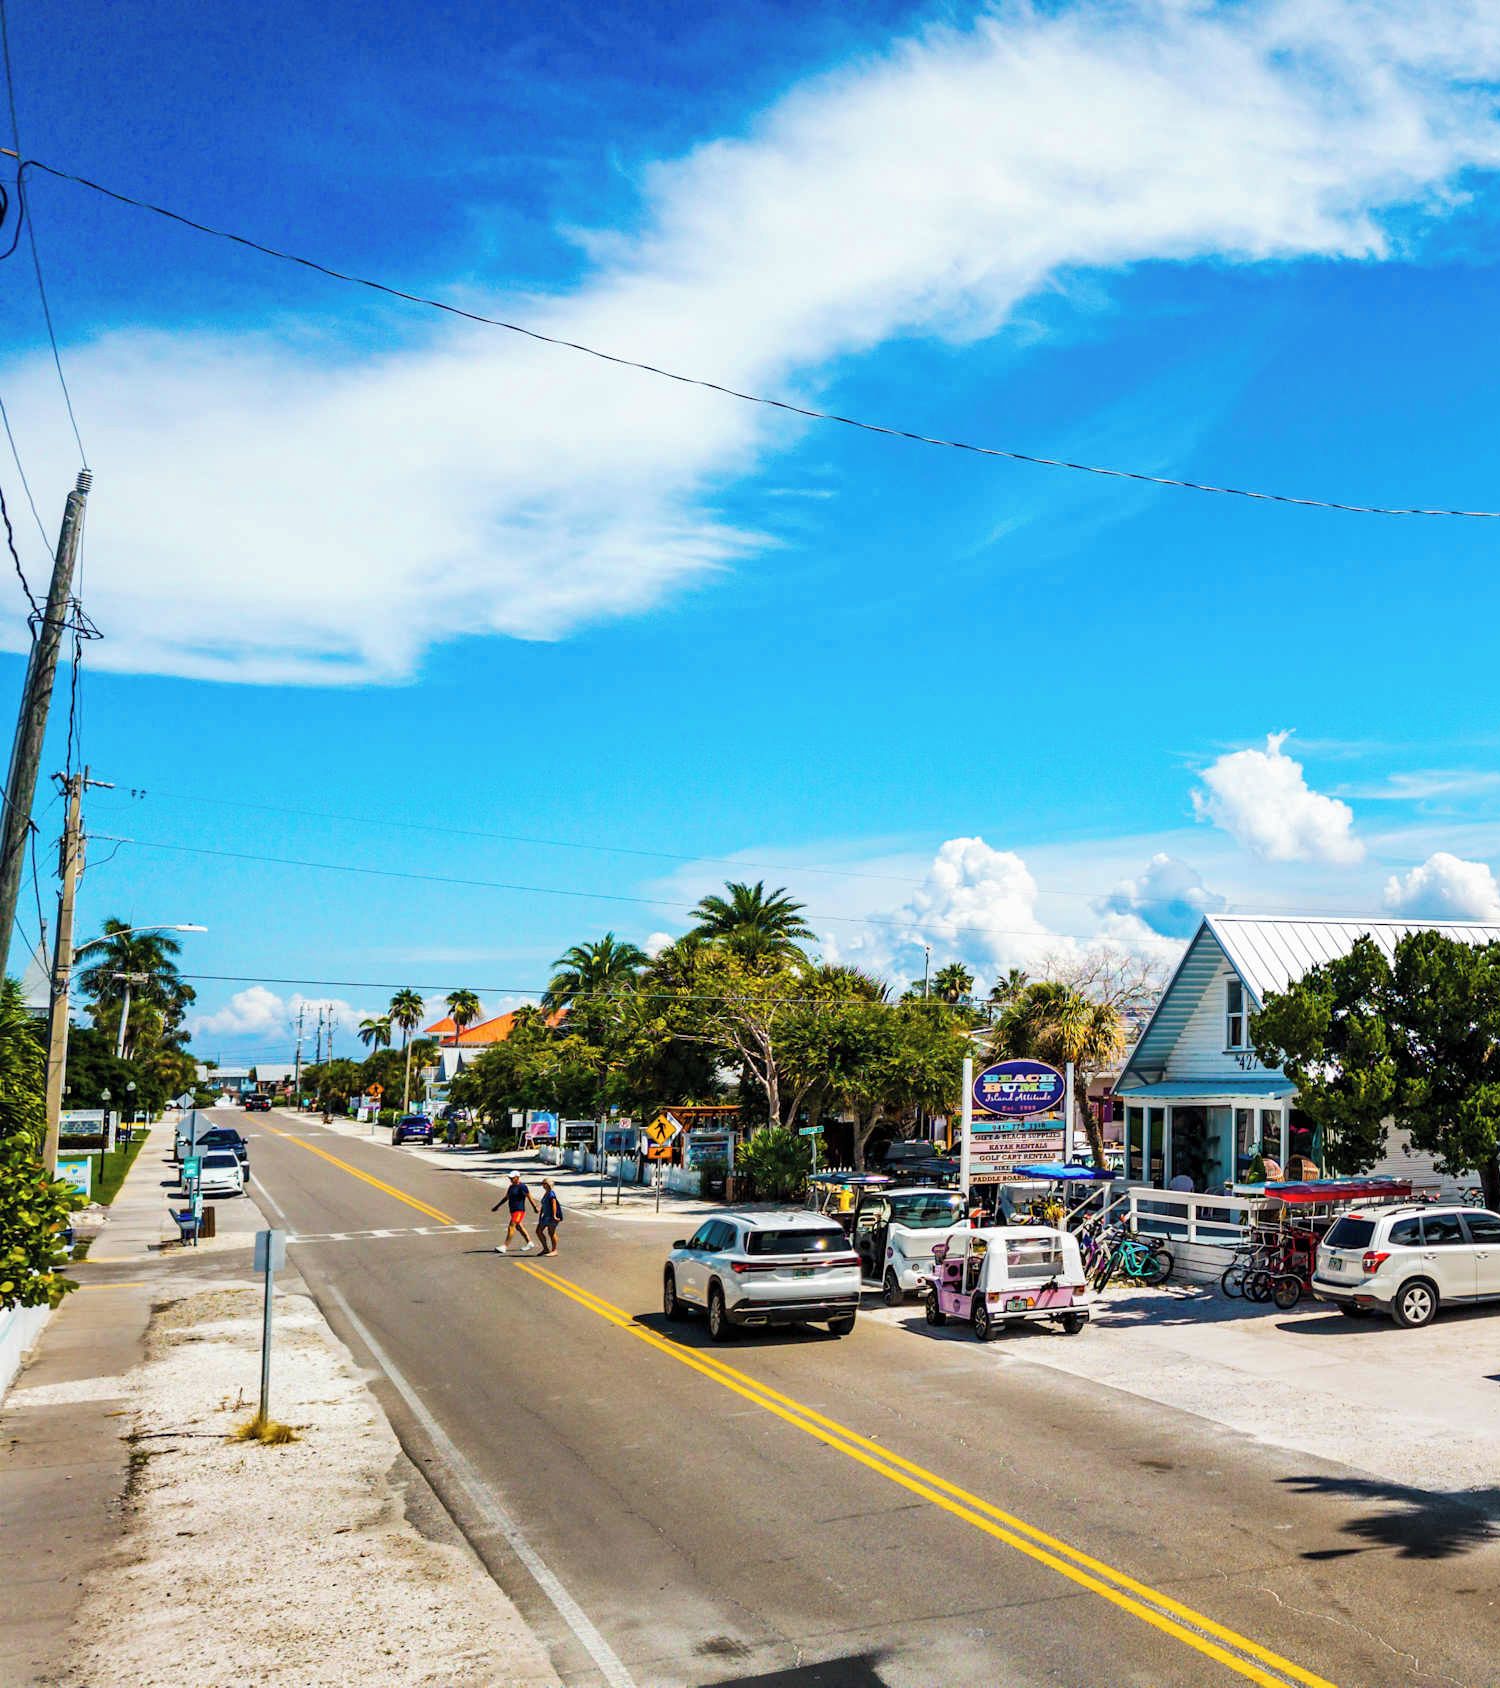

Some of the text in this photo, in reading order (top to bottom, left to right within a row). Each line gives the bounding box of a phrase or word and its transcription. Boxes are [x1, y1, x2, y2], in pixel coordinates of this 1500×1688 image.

[983, 1074, 1057, 1083] BEACH
[982, 1083, 1056, 1093] BUMS
[985, 1091, 1052, 1102] Island Attitude
[1028, 1131, 1061, 1139] SUPPLIES
[1015, 1142, 1048, 1150] RENTALS
[979, 1152, 1056, 1162] GOLF CART RENTALS
[994, 1164, 1010, 1172] BIKE
